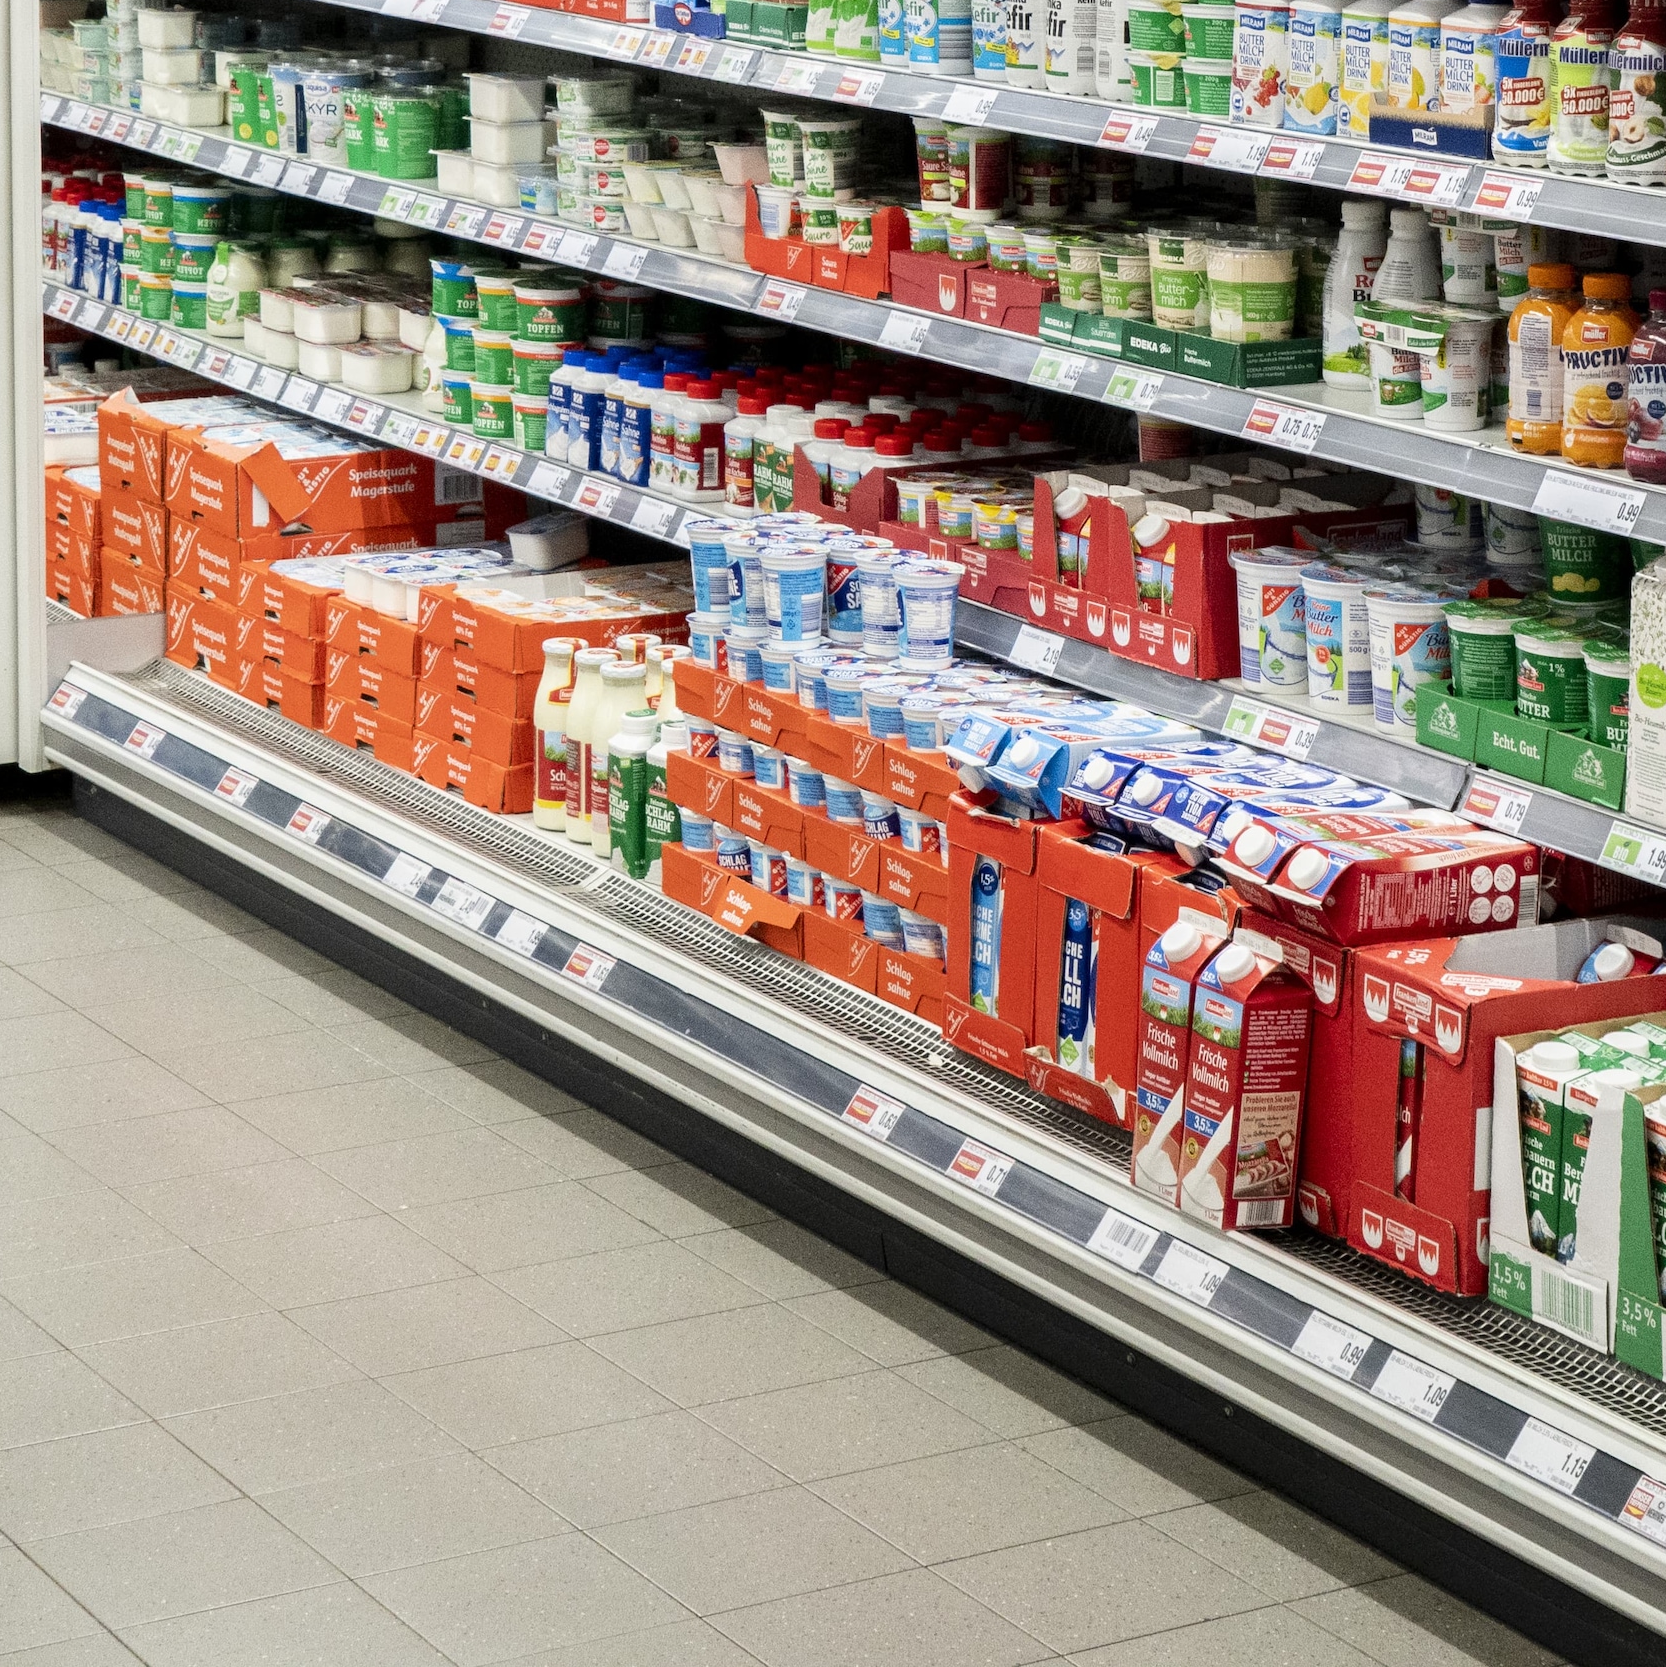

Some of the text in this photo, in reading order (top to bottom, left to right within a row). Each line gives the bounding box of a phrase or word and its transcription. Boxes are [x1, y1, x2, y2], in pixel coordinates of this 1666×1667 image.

[1239, 33, 1264, 48] BUTTER
[1239, 54, 1261, 67] DRINK
[1502, 86, 1545, 105] 50.000€
[1130, 337, 1172, 354] EDEKA Bio
[349, 464, 418, 482] Speisequark
[350, 482, 415, 499] Magerstufe
[889, 759, 917, 779] Schlag-
[891, 782, 915, 798] sahne
[1198, 1044, 1227, 1071] Frische
[1192, 1063, 1229, 1093] Vollmilch
